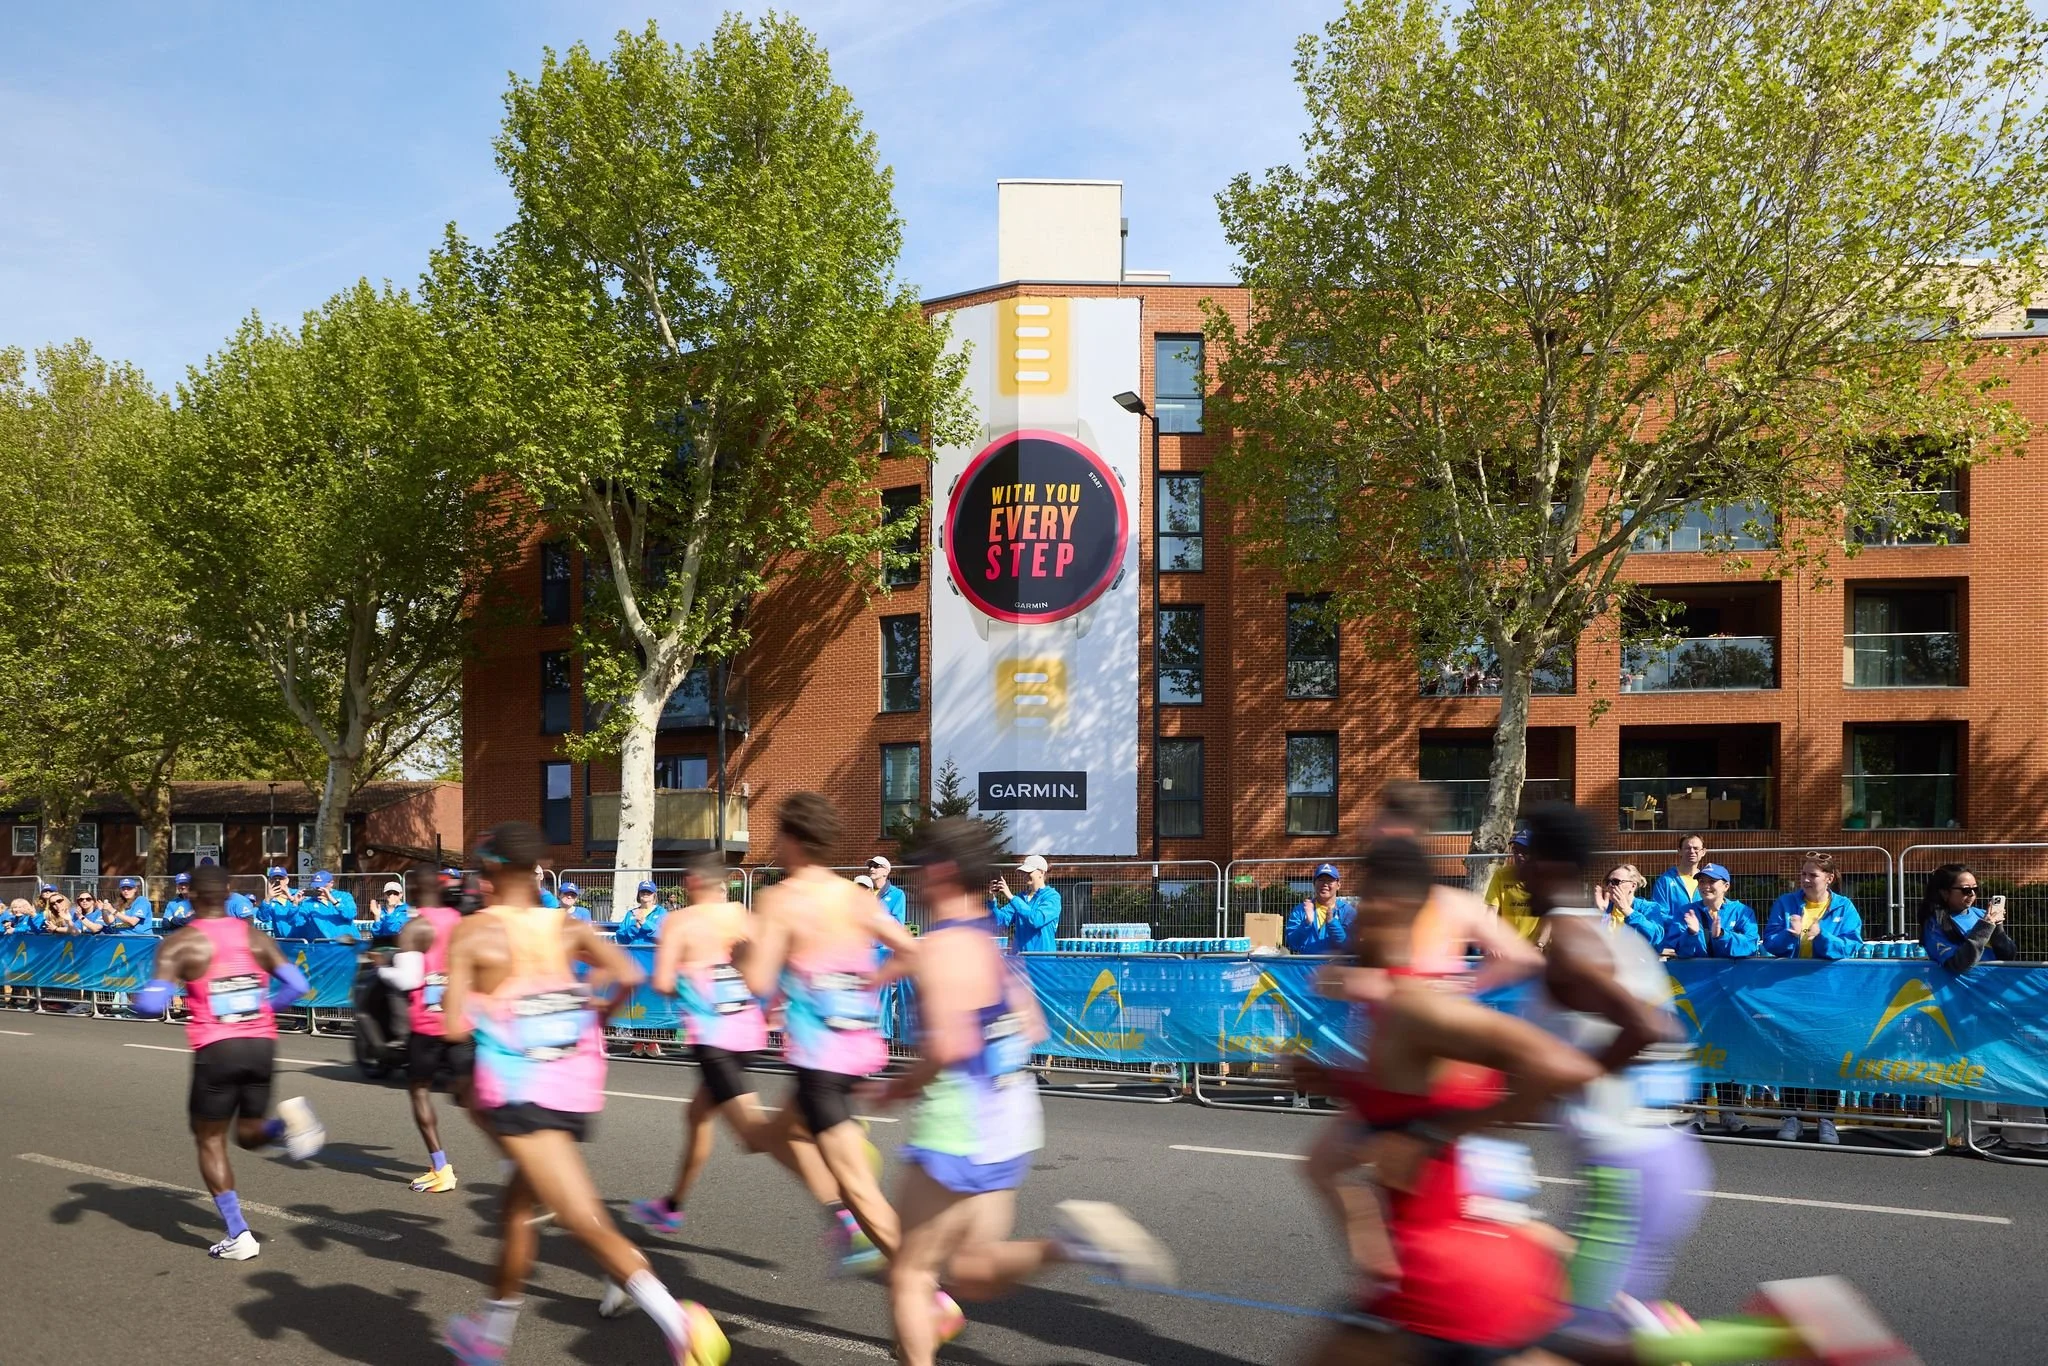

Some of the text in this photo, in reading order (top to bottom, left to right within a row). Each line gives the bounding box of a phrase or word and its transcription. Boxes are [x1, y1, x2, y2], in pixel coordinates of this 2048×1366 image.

[1088, 472, 1103, 489] START
[992, 484, 1080, 505] WITH YOU
[989, 505, 1079, 542] EVERY
[985, 543, 1075, 580] STEP
[84, 854, 96, 863] 20
[1065, 1023, 1145, 1050] Lucozade
[1838, 1051, 1985, 1087] Lucozade
